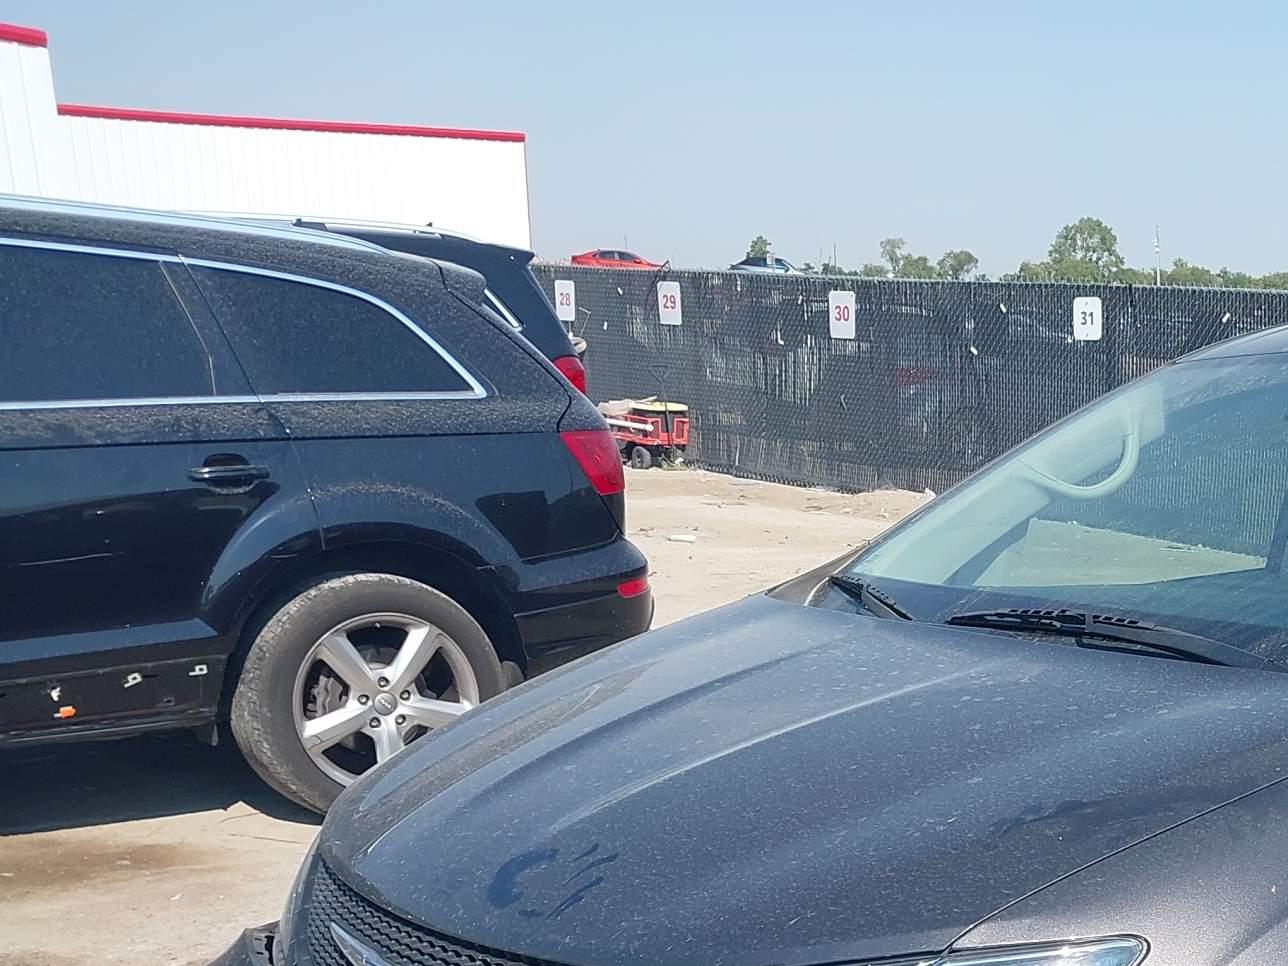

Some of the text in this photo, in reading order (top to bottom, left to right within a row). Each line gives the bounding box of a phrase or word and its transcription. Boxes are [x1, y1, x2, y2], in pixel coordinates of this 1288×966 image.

[560, 292, 571, 306] 28
[662, 294, 677, 309] 29
[834, 304, 850, 322] 30
[1080, 311, 1094, 326] 31
